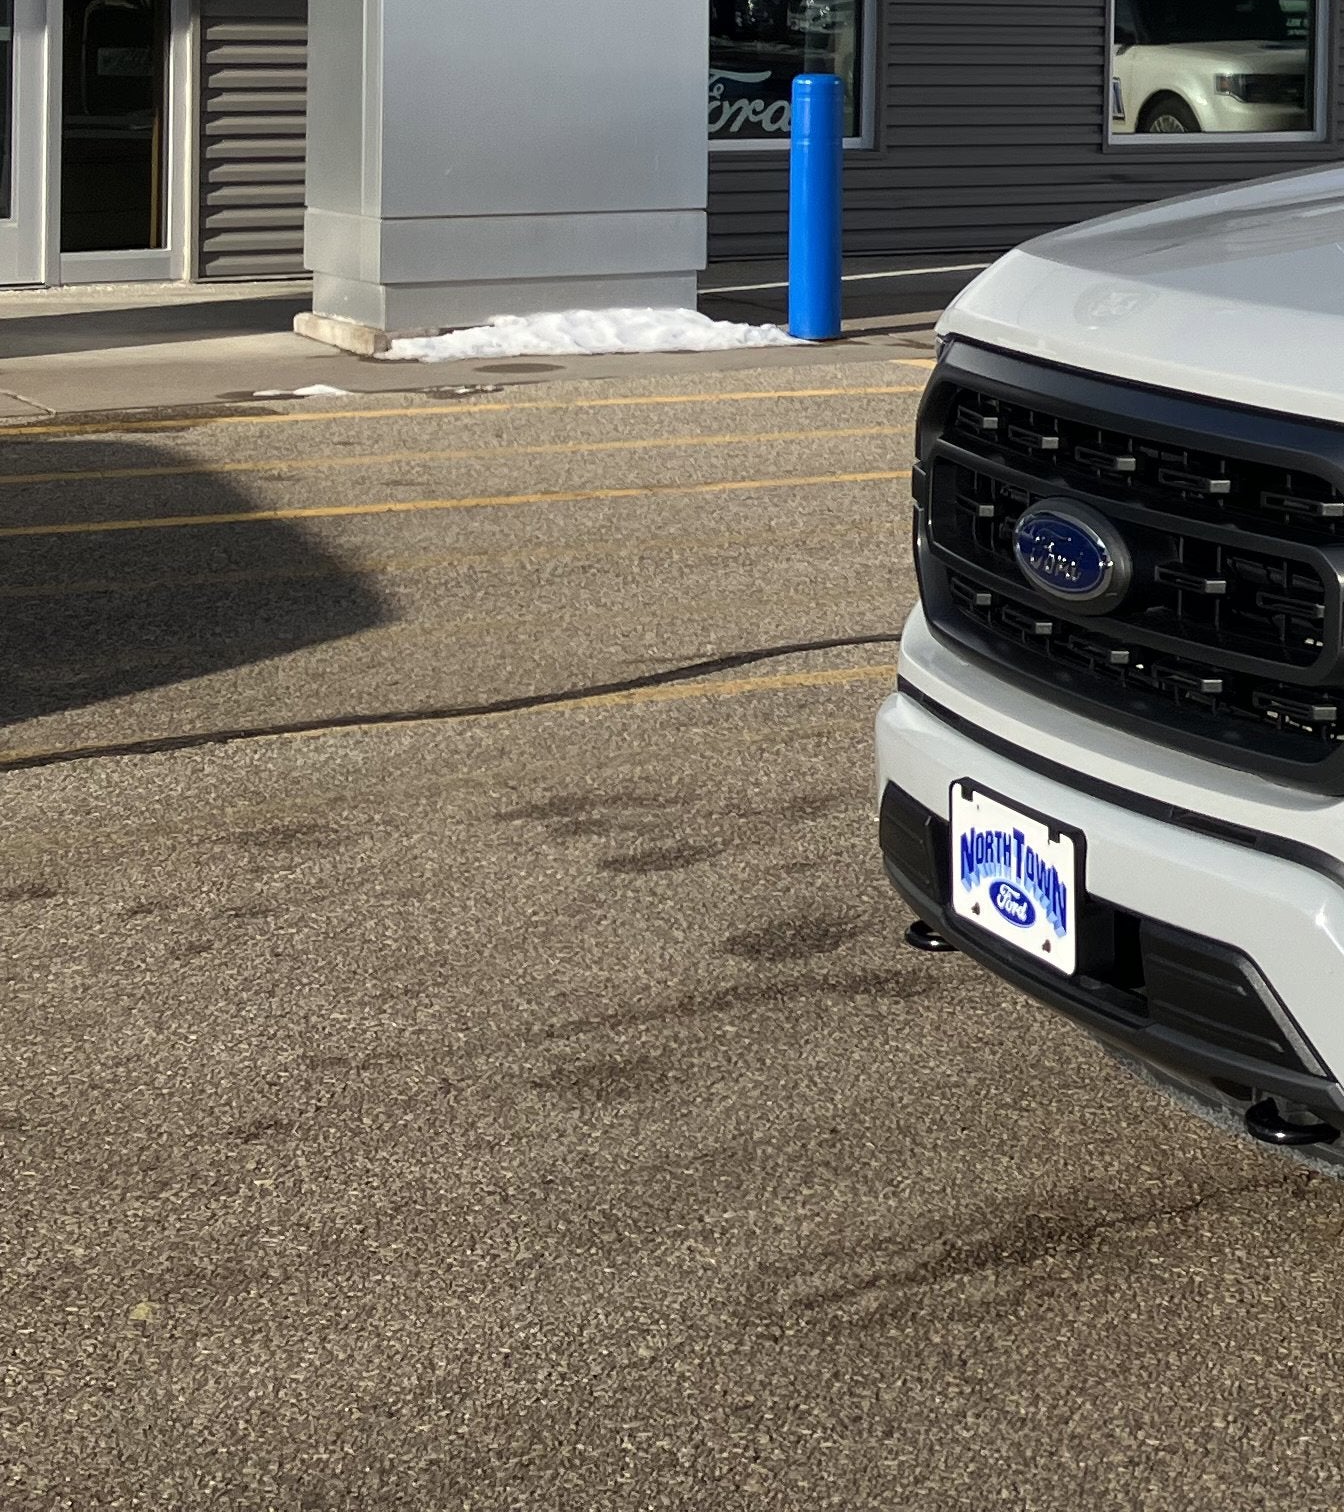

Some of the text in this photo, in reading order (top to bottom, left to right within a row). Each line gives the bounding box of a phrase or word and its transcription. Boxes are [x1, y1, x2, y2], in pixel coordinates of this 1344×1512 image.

[960, 827, 1067, 934] NORTH TOWN
[996, 883, 1028, 922] Ford
